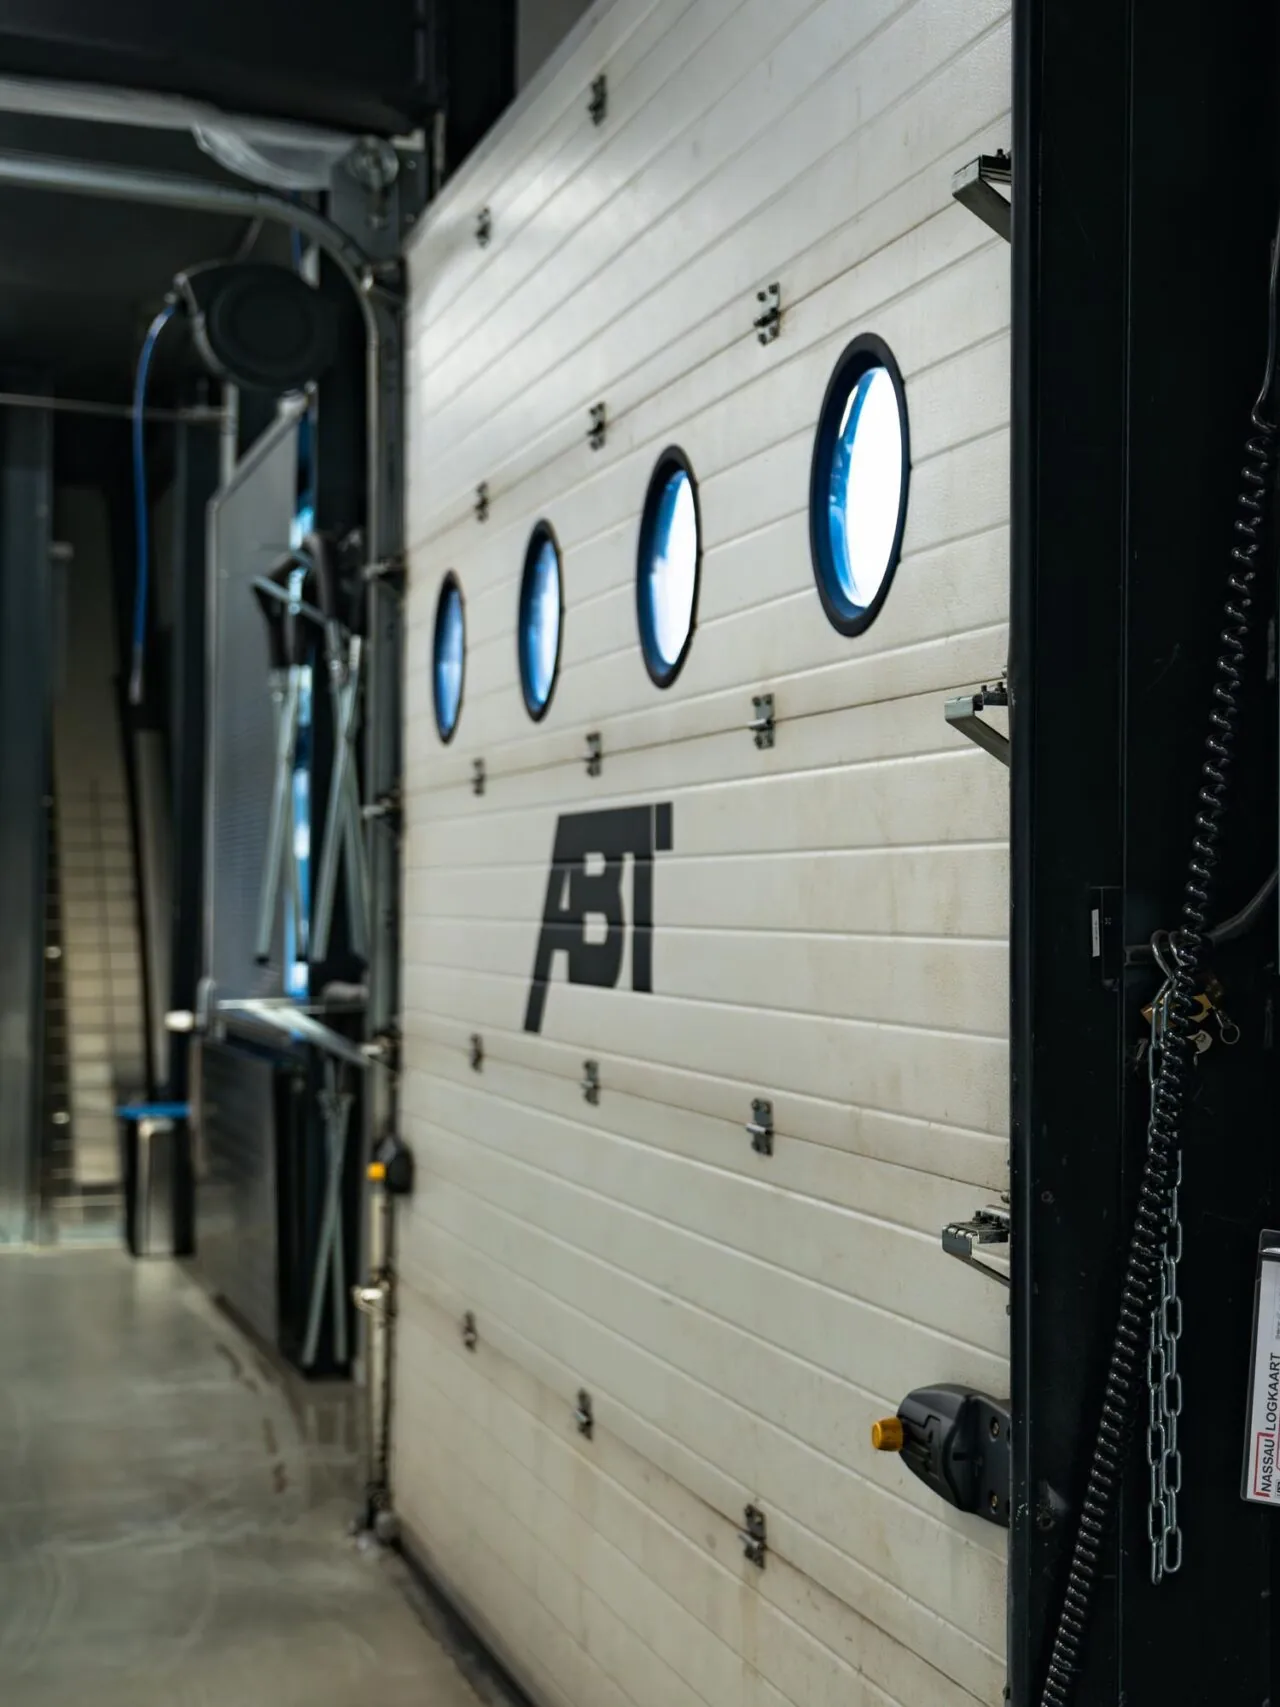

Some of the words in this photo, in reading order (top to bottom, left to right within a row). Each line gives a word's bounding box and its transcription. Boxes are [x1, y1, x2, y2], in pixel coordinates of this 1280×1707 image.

[523, 801, 673, 1034] ABT
[1265, 1352, 1280, 1432] LOGKAART
[1261, 1439, 1275, 1492] NASSAU
